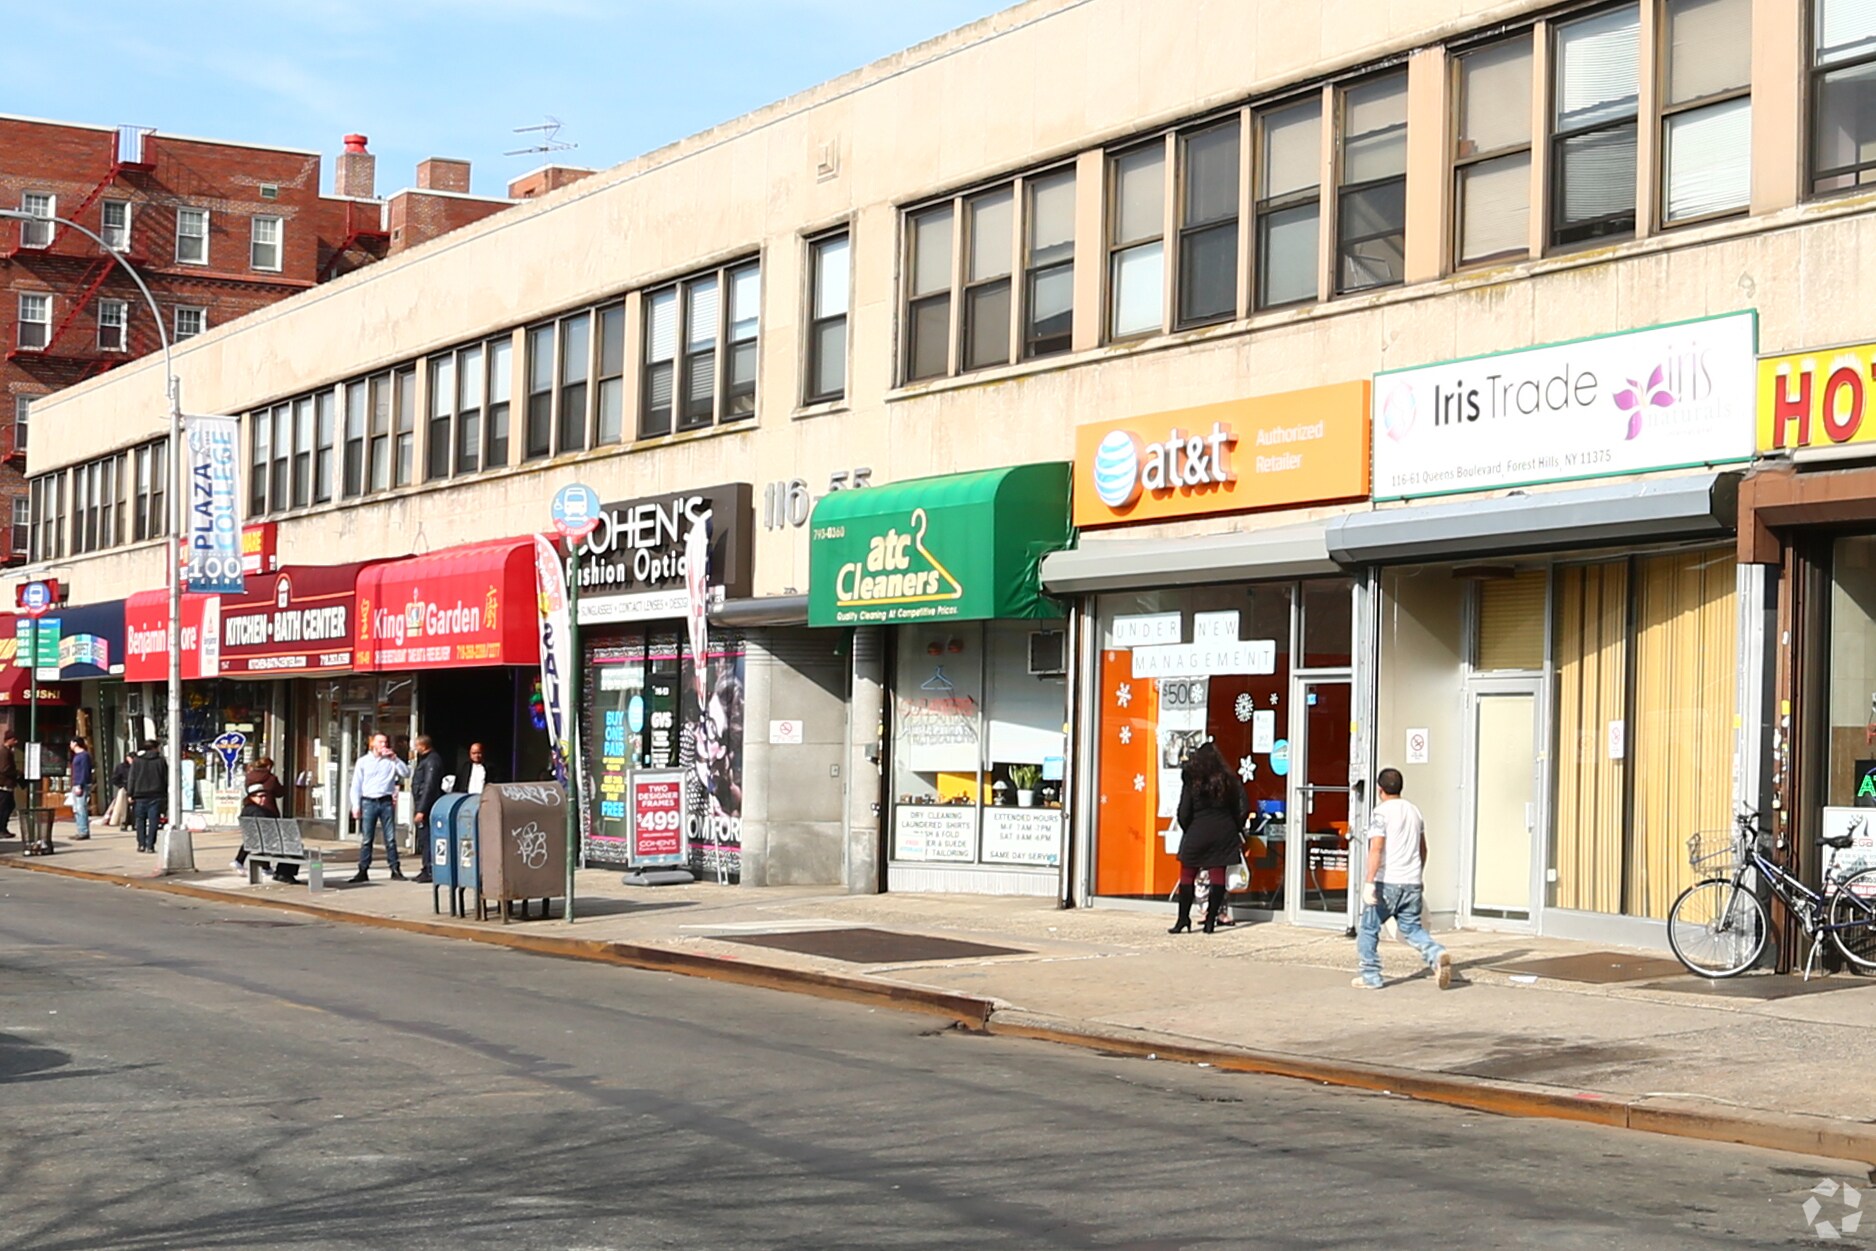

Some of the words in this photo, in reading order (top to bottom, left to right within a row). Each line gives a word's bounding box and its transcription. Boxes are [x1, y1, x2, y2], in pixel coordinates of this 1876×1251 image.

[1773, 363, 1876, 449] HO
[1141, 421, 1228, 490] at&t
[1255, 420, 1324, 447] Authorized
[1255, 454, 1303, 474] Retailer
[1391, 472, 1420, 487] 116-61
[1423, 469, 1454, 484] Queens
[1507, 458, 1536, 473] Forest
[1565, 453, 1577, 466] NY
[1581, 449, 1612, 464] 11375
[212, 431, 236, 550] COLLEGE
[193, 463, 214, 550] PLAZA
[866, 528, 912, 573] atc
[188, 557, 242, 578] 100
[836, 562, 940, 602] Cleaners
[618, 602, 643, 614] CONTACT
[836, 611, 858, 622] Quality
[859, 609, 887, 621] Cleaning
[897, 606, 936, 619] Competitive
[225, 613, 268, 647] KITCHEN
[273, 610, 302, 642] BATH
[302, 606, 347, 640] CENTER
[373, 608, 405, 647] King
[426, 600, 480, 636] Garden
[1116, 621, 1177, 639] UNDER
[1199, 620, 1237, 636] NEW
[127, 621, 167, 662] Benjamin
[1135, 651, 1270, 670] MANAGEMENT
[605, 711, 625, 726] BUY
[605, 726, 625, 741] ONE
[604, 741, 625, 756] PAIR
[638, 792, 679, 801] DESIGNER
[648, 785, 668, 793] TWO
[601, 801, 625, 818] FREE
[641, 799, 675, 808] FRAMES
[636, 810, 680, 831] $499
[910, 811, 924, 819] DRY
[927, 811, 962, 819] CLEANING
[994, 813, 1031, 822] EXTENDED
[1033, 814, 1059, 823] HOURS
[687, 814, 742, 842] OMFOR
[901, 821, 942, 829] LAUNDERED
[946, 822, 970, 830] SHIRTS
[932, 848, 969, 857] TAILORING
[944, 840, 967, 848] SUEDE
[990, 851, 1010, 859] SAME
[1012, 852, 1026, 860] DAY
